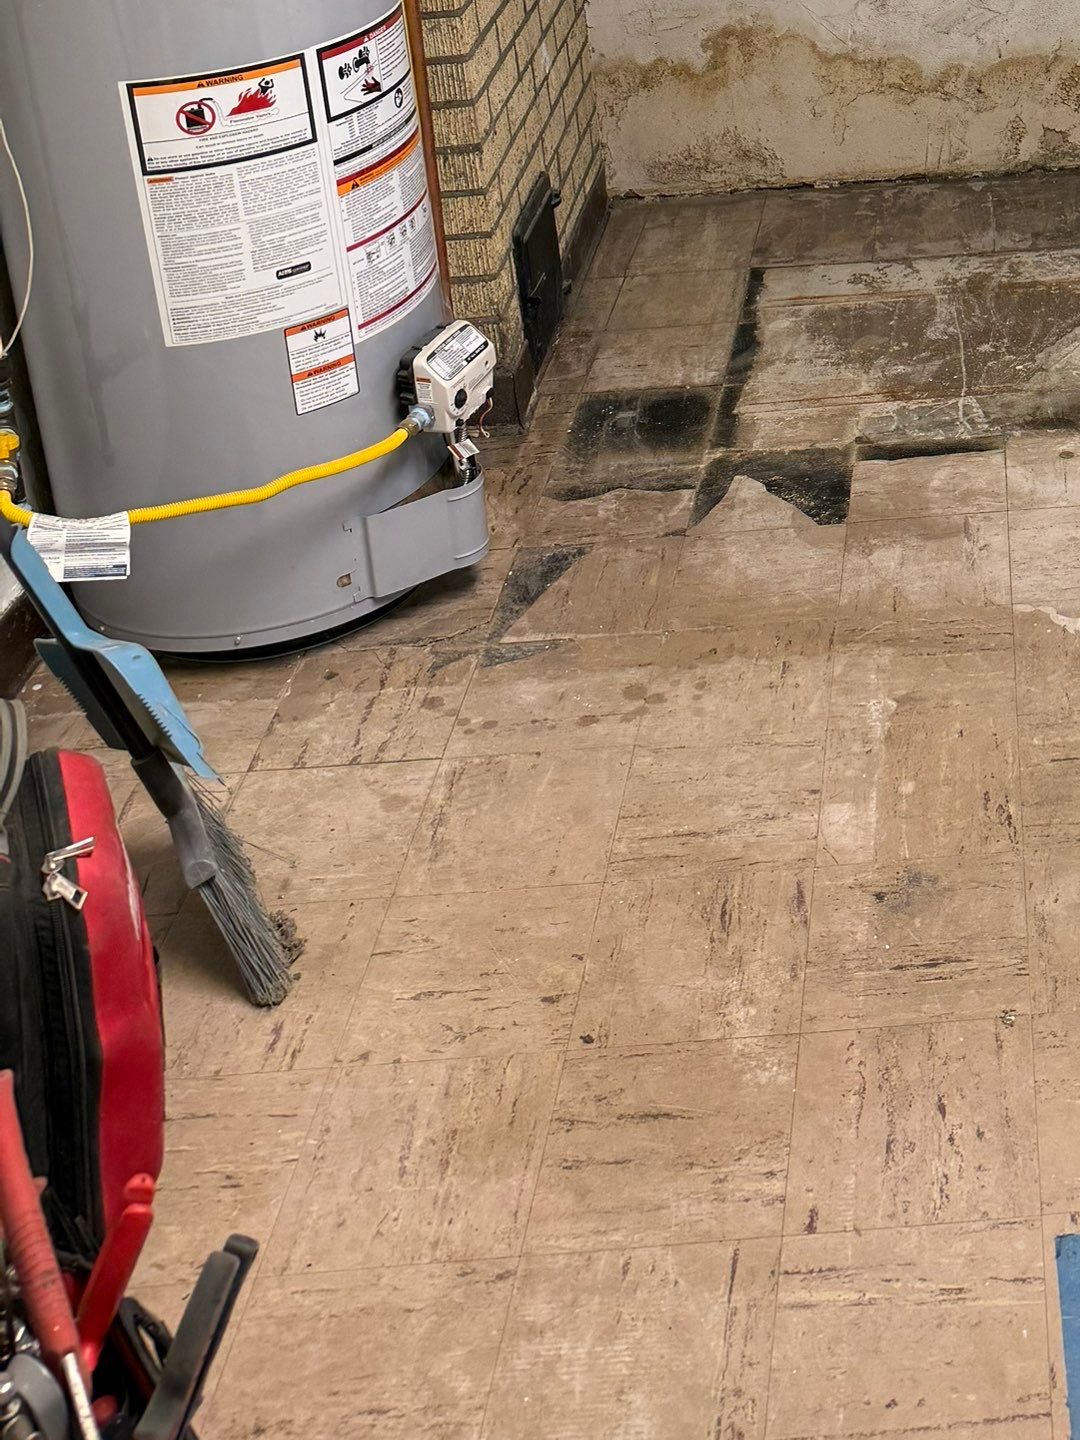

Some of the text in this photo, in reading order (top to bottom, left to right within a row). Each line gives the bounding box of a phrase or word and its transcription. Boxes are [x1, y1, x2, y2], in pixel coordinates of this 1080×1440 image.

[369, 24, 387, 40] DANGER
[205, 75, 244, 87] WARNING
[306, 315, 336, 329] WARNING
[312, 360, 342, 376] WARNING
